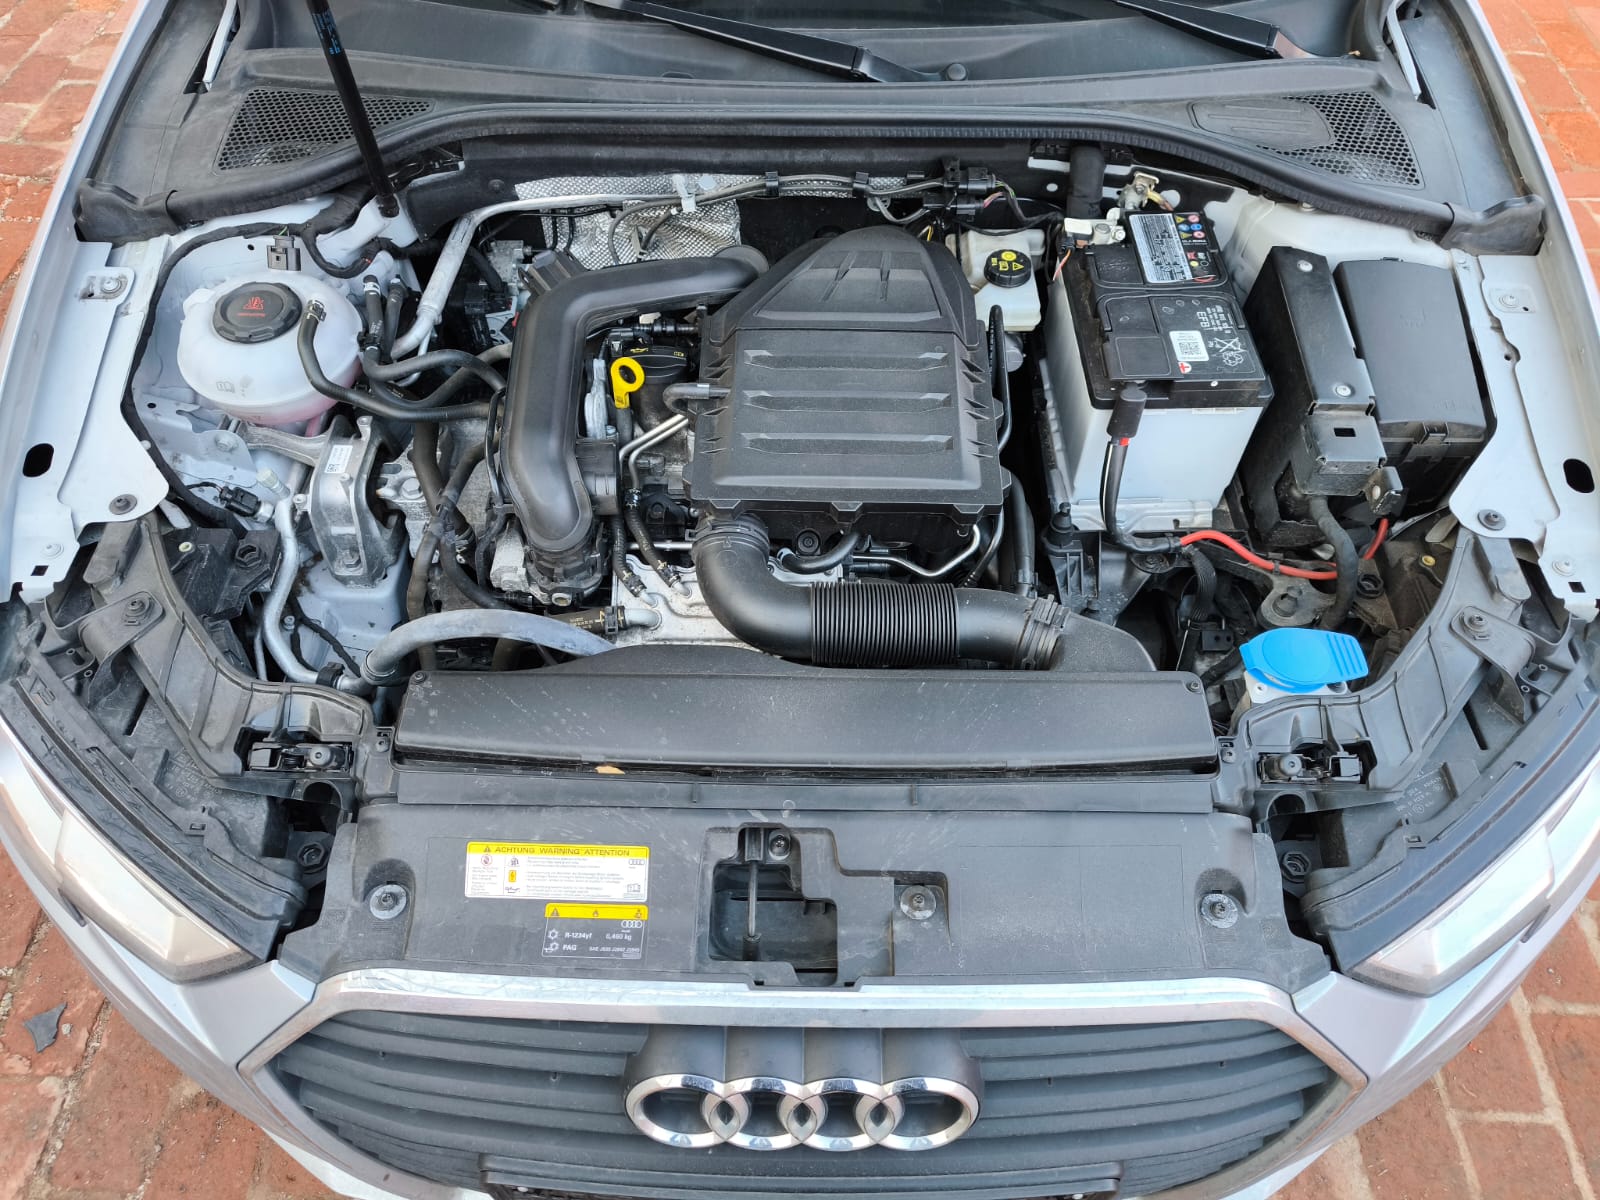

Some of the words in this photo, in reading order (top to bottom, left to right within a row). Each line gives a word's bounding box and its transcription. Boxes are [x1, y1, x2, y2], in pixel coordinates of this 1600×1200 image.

[1197, 311, 1211, 328] EFB
[494, 846, 535, 854] ACHTUNG
[539, 847, 580, 855] WARNING
[584, 849, 630, 857] ATTENTION
[564, 931, 592, 940] R-1234yf
